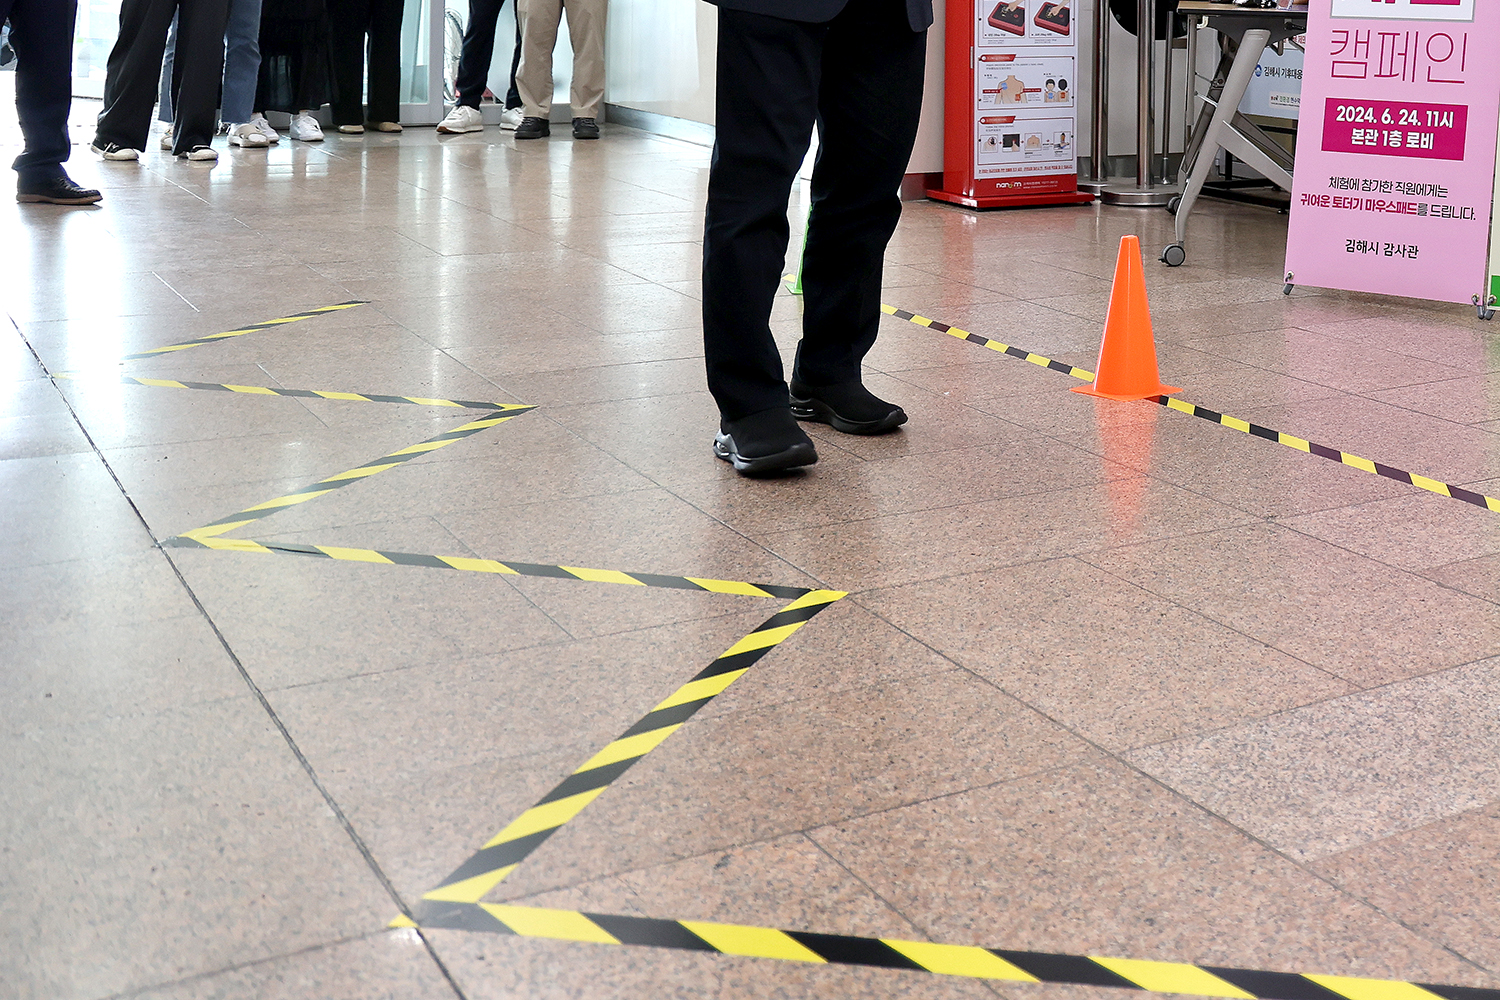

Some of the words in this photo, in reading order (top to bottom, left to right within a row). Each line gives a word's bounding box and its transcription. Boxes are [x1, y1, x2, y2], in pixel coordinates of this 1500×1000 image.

[1330, 29, 1467, 84] 캠페인
[1336, 105, 1378, 124] 2024.
[1381, 108, 1395, 125] 6.
[1398, 110, 1422, 126] 24.
[1426, 110, 1454, 128] 11시
[1351, 128, 1379, 146] 본관
[1382, 130, 1402, 147] 1층
[1406, 132, 1434, 150] 로비
[1328, 176, 1360, 191] 체험에
[1361, 179, 1393, 193] 참가한
[1395, 181, 1449, 198] 직원에게는
[1300, 194, 1331, 208] 귀여운
[1332, 196, 1363, 210] 토더기
[1365, 199, 1428, 217] 마우스패드를
[1429, 204, 1476, 221] 드립니다.
[1345, 239, 1379, 255] 김해시
[1383, 243, 1419, 259] 감사관
